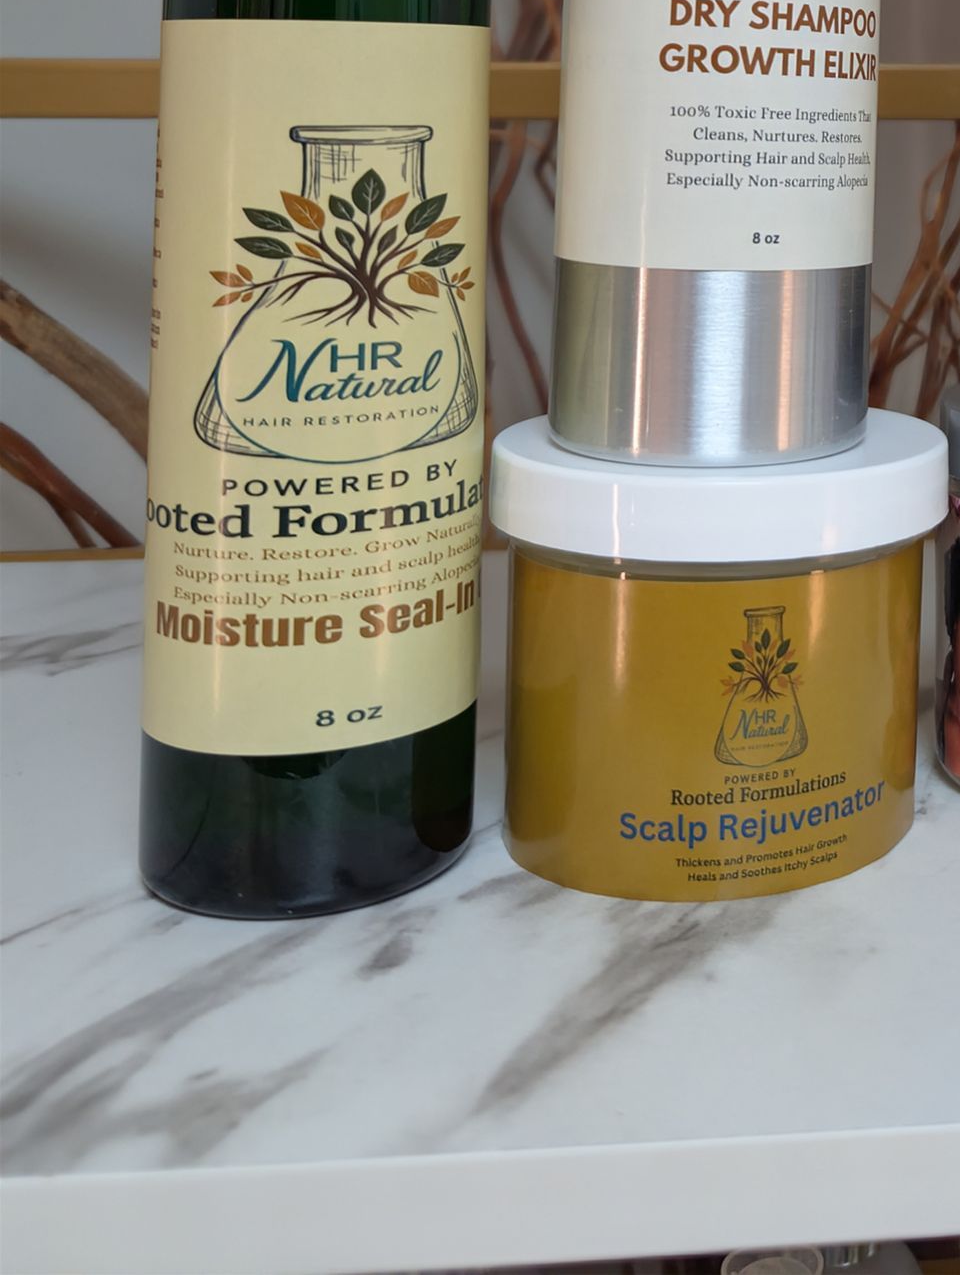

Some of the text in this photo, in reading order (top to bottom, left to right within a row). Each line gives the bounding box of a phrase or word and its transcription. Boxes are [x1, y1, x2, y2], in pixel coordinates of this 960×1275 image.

[749, 0, 877, 38] SHAMPOO
[659, 43, 877, 82] GROWTH ELIXIR
[670, 105, 710, 118] 100%
[714, 105, 756, 120] Toxic
[760, 107, 792, 121] Free
[795, 108, 857, 124] Ingredients
[693, 127, 748, 143] Cleans,
[752, 129, 818, 144] Nurtures.
[665, 149, 752, 166] Supporting
[756, 151, 788, 165] Hair
[791, 152, 815, 165] and
[818, 153, 846, 168] Scalp
[666, 173, 869, 191] Especially Non-scarring Alopecia
[752, 232, 780, 244] 8 oz
[235, 338, 443, 403] Natural
[243, 406, 439, 427] HAIR RESTORATION
[223, 460, 457, 496] POWERED BY
[147, 498, 253, 538] ooted
[174, 542, 254, 562] Nurture.
[262, 546, 357, 561] Restore.
[365, 536, 419, 554] Grow
[176, 565, 290, 586] Supporting
[298, 567, 345, 582] hair
[352, 561, 392, 577] and
[398, 551, 444, 571] scalp
[174, 586, 272, 608] Especially
[281, 576, 427, 605] Non-scarring
[156, 600, 343, 647] Moisture
[360, 579, 475, 639] Seal-In
[316, 705, 383, 727] 8 oz
[671, 771, 846, 806] Rooted Formulations
[724, 768, 796, 785] POWERED BY
[620, 781, 885, 849] Scalp Rejuvenator
[676, 833, 848, 867] Thickens and Promotes Hair Growth
[688, 852, 838, 882] Heals and Soothes Itchy Scalps
